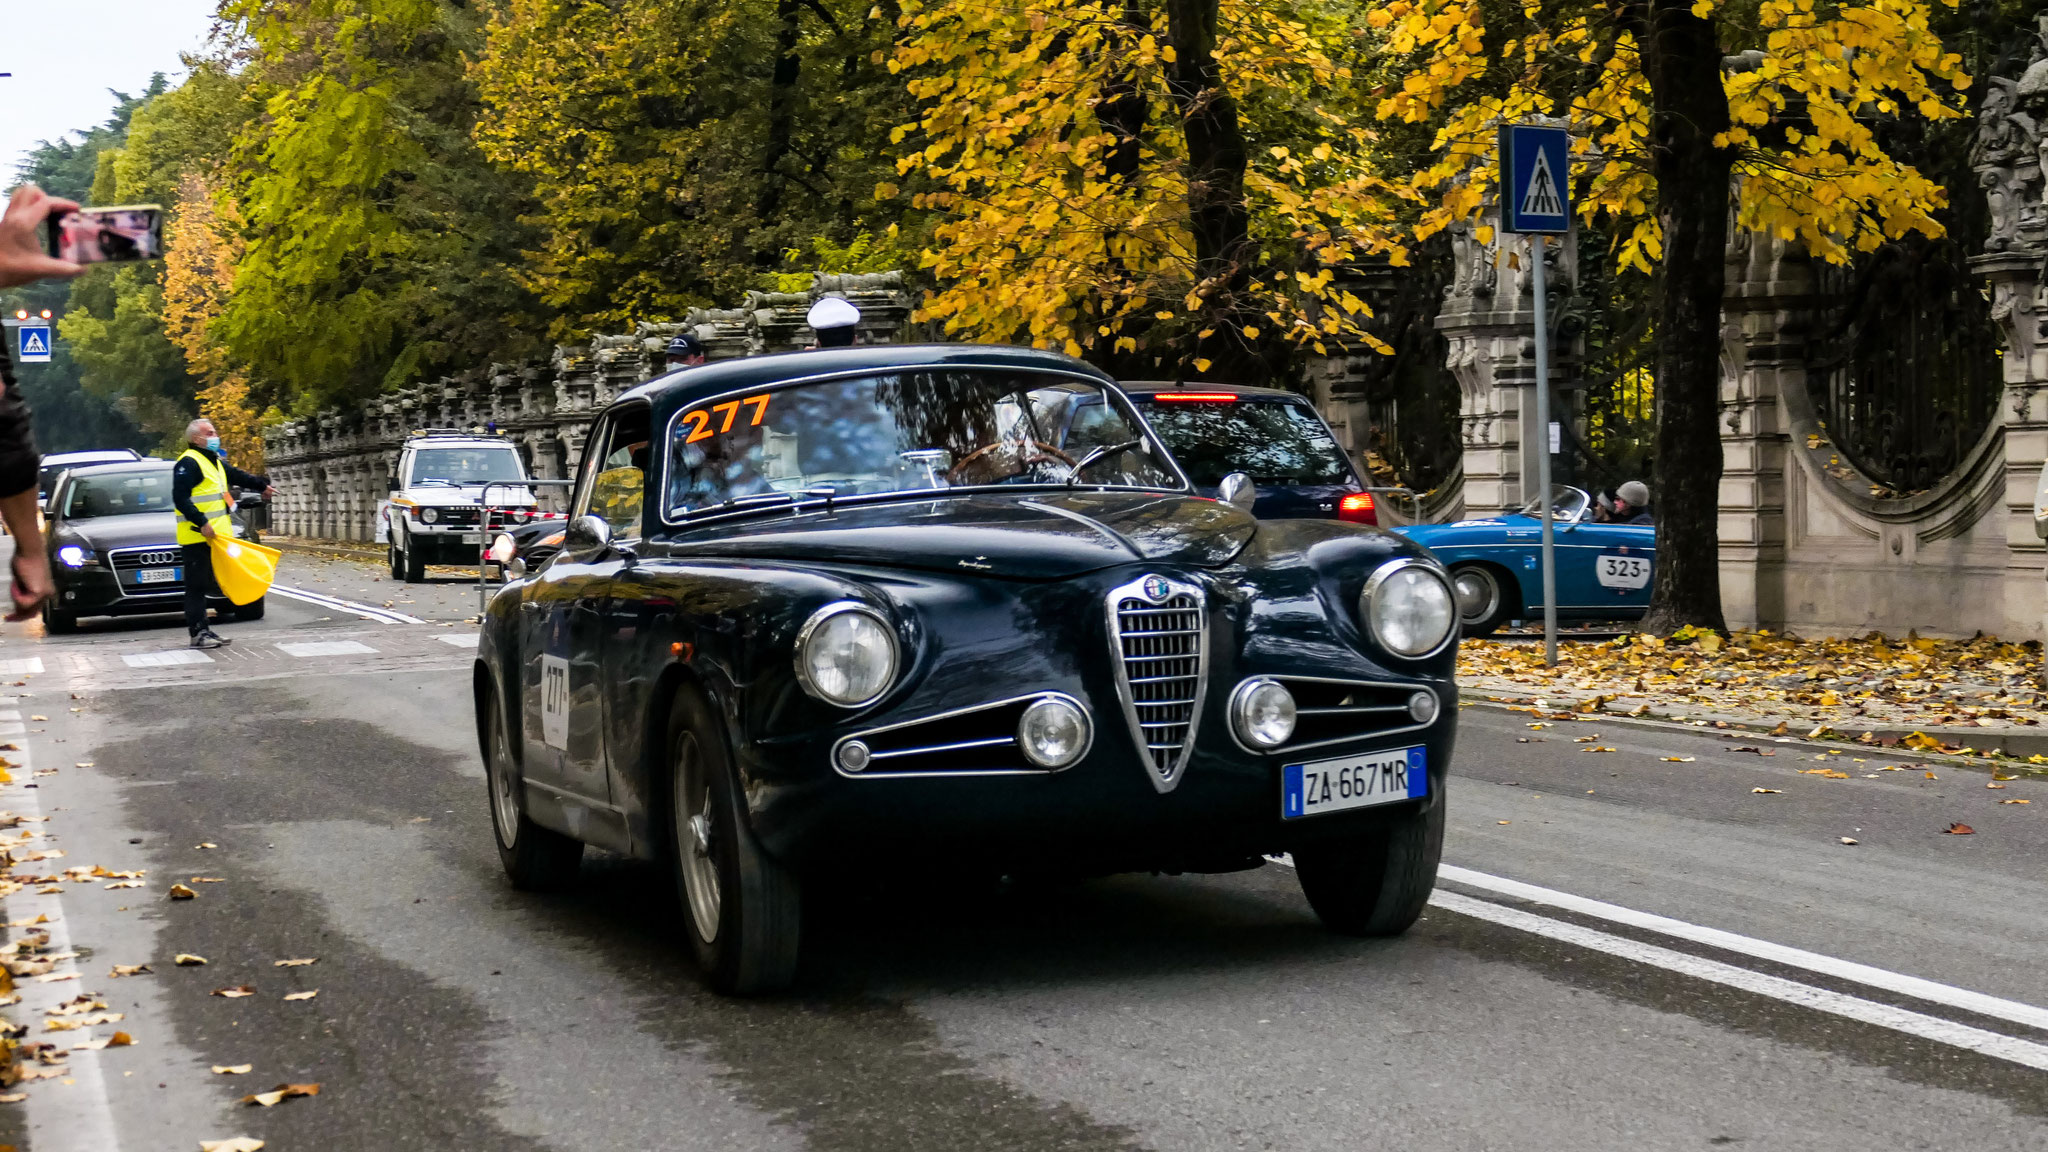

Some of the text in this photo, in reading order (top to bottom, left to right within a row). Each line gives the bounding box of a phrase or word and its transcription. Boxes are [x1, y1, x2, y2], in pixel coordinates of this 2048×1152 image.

[682, 393, 771, 444] 277
[1606, 559, 1641, 578] 323
[547, 665, 564, 716] 277
